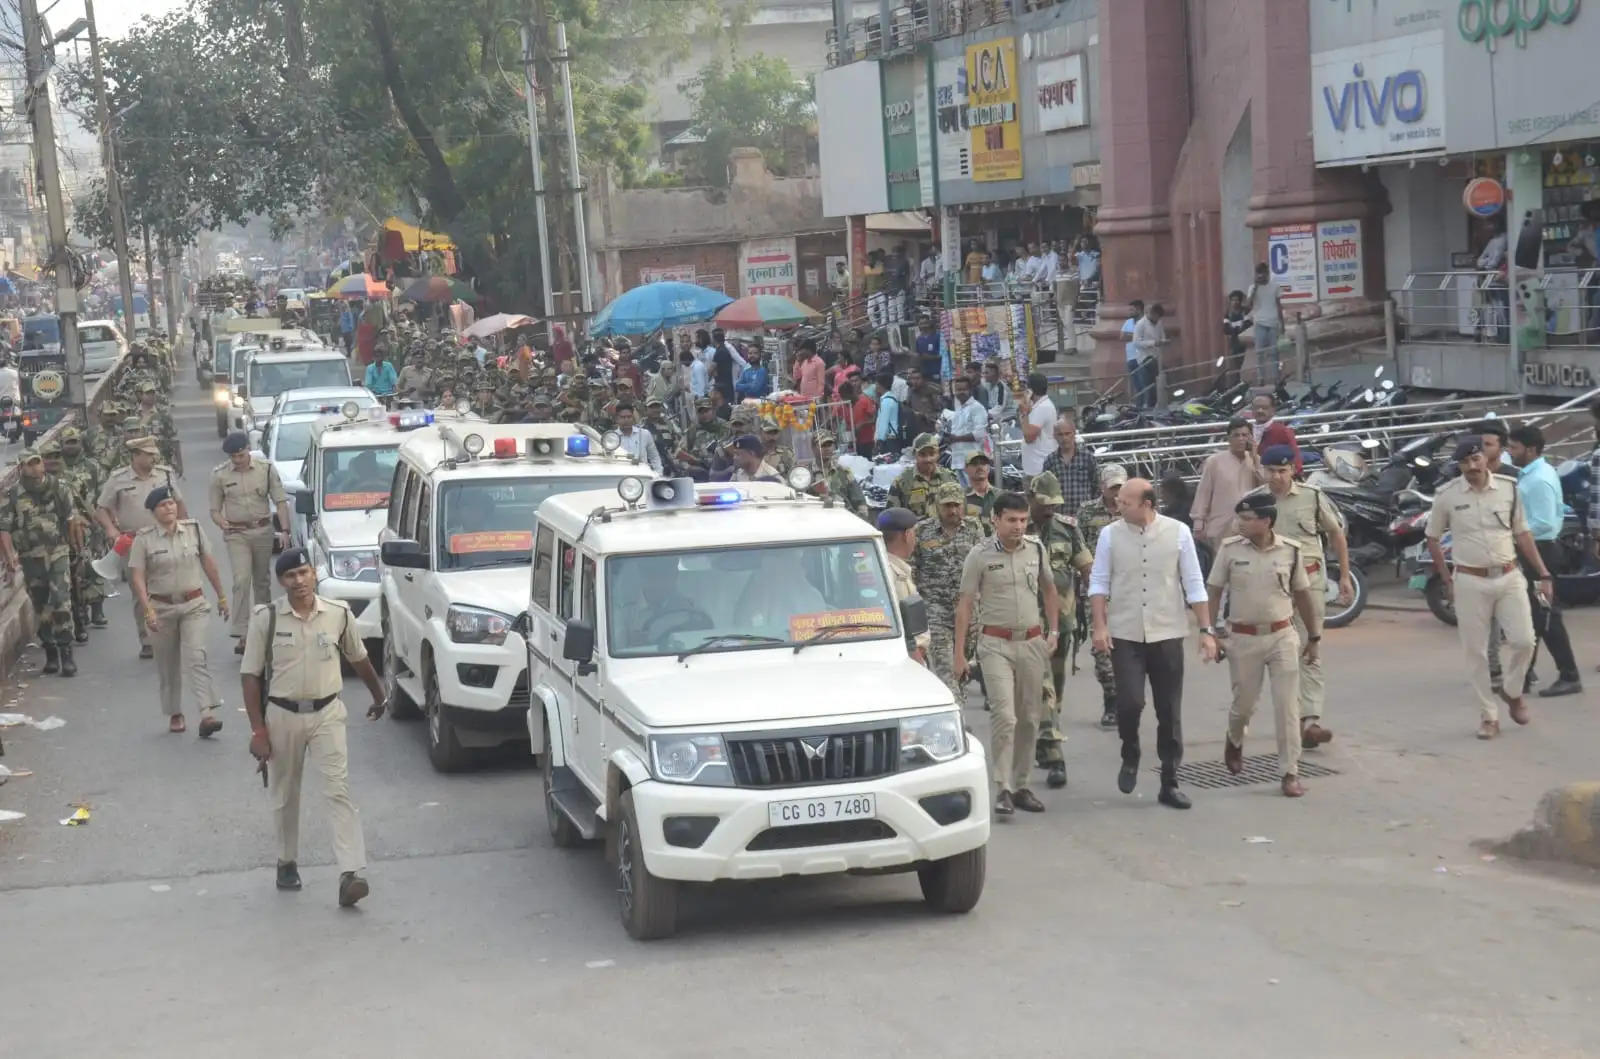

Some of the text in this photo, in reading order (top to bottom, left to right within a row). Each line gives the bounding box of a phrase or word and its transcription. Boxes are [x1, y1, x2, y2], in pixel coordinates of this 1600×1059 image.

[971, 46, 1009, 93] JCA
[1323, 61, 1427, 132] vivo
[782, 798, 871, 821] CG 03 7480
